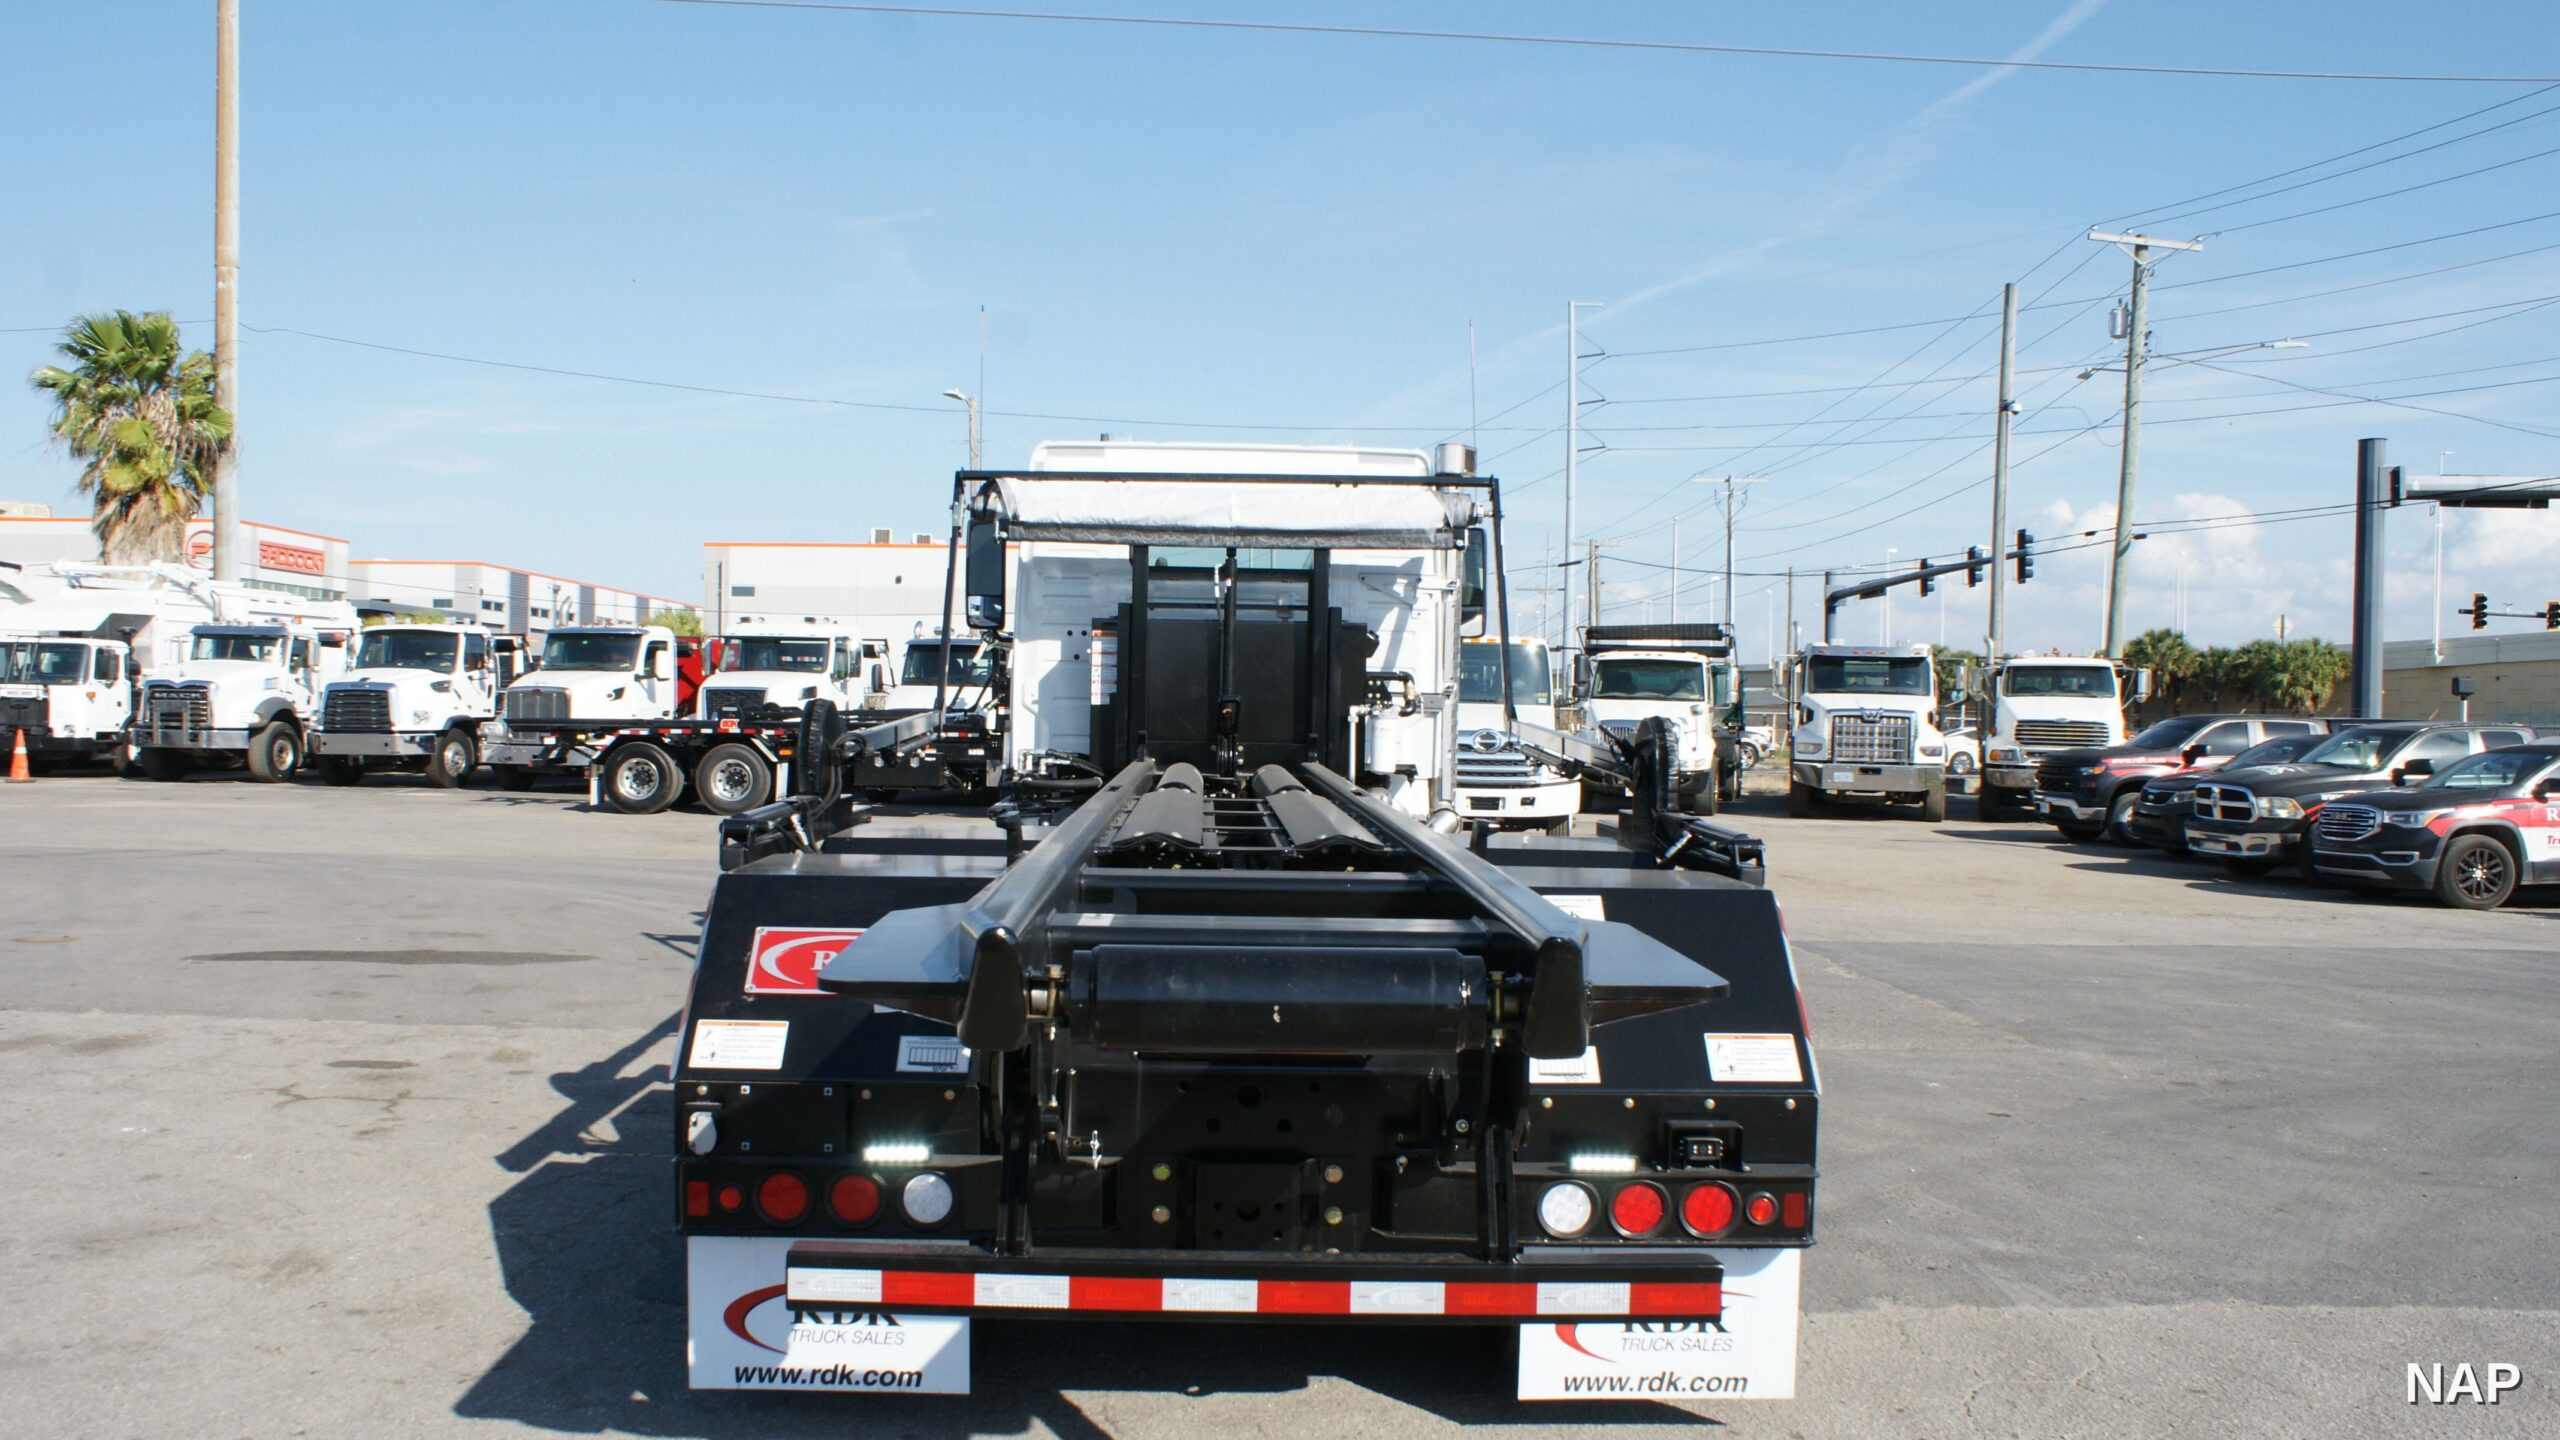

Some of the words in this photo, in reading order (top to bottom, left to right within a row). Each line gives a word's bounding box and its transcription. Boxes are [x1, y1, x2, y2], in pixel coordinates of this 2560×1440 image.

[792, 1328, 847, 1344] TRUCK
[852, 1331, 905, 1345] SALES
[1621, 1337, 1676, 1351] TRUCK
[1680, 1338, 1734, 1352] SALES
[734, 1364, 923, 1388] www.rdk.com
[1563, 1371, 1748, 1392] www.rdk.com
